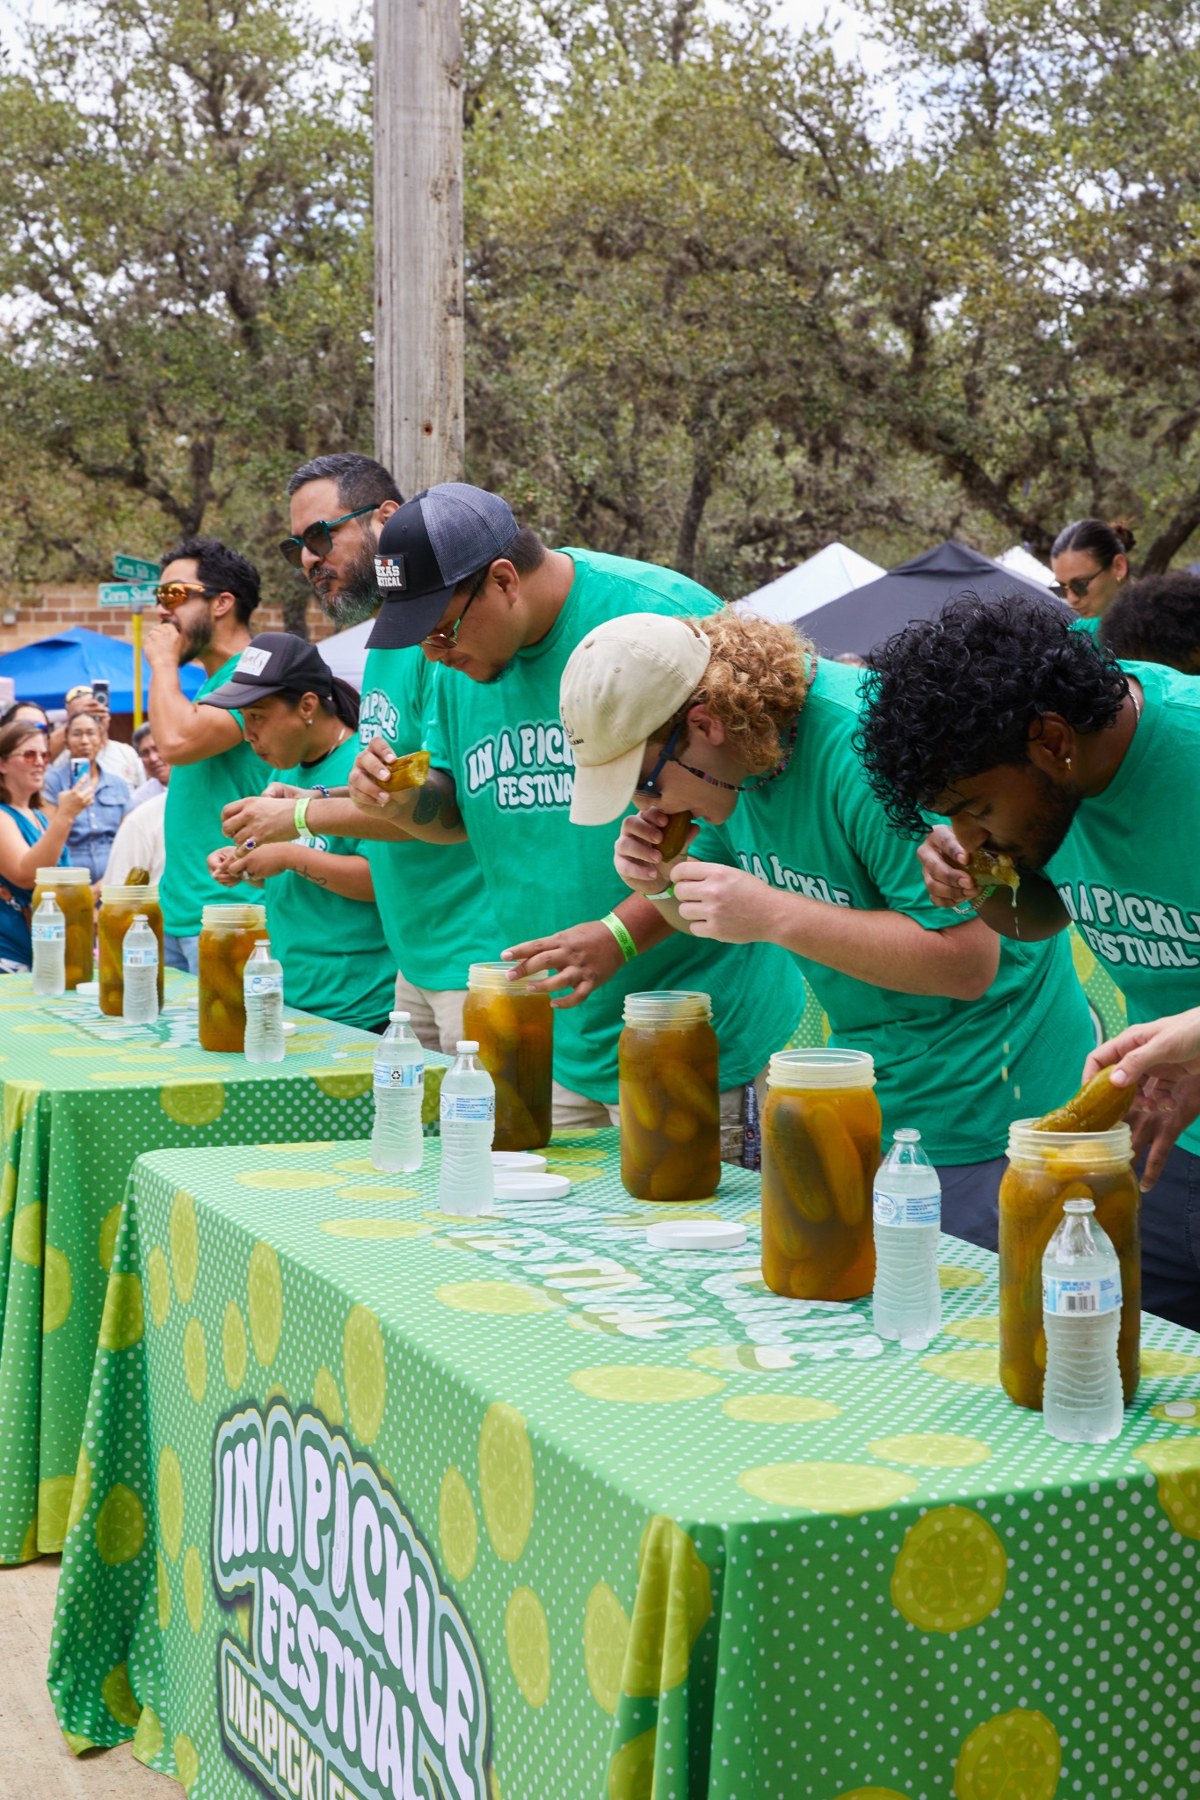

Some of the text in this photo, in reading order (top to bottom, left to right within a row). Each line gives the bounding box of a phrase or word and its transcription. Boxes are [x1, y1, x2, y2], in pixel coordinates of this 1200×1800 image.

[99, 587, 129, 603] Corn
[468, 742, 495, 791] IN
[498, 733, 515, 772] A
[497, 772, 575, 806] FESTIVA
[1058, 884, 1200, 943] N A PICKL
[221, 1435, 475, 1800] IN A PICKLE
[261, 1566, 425, 1800] FESTIVAL
